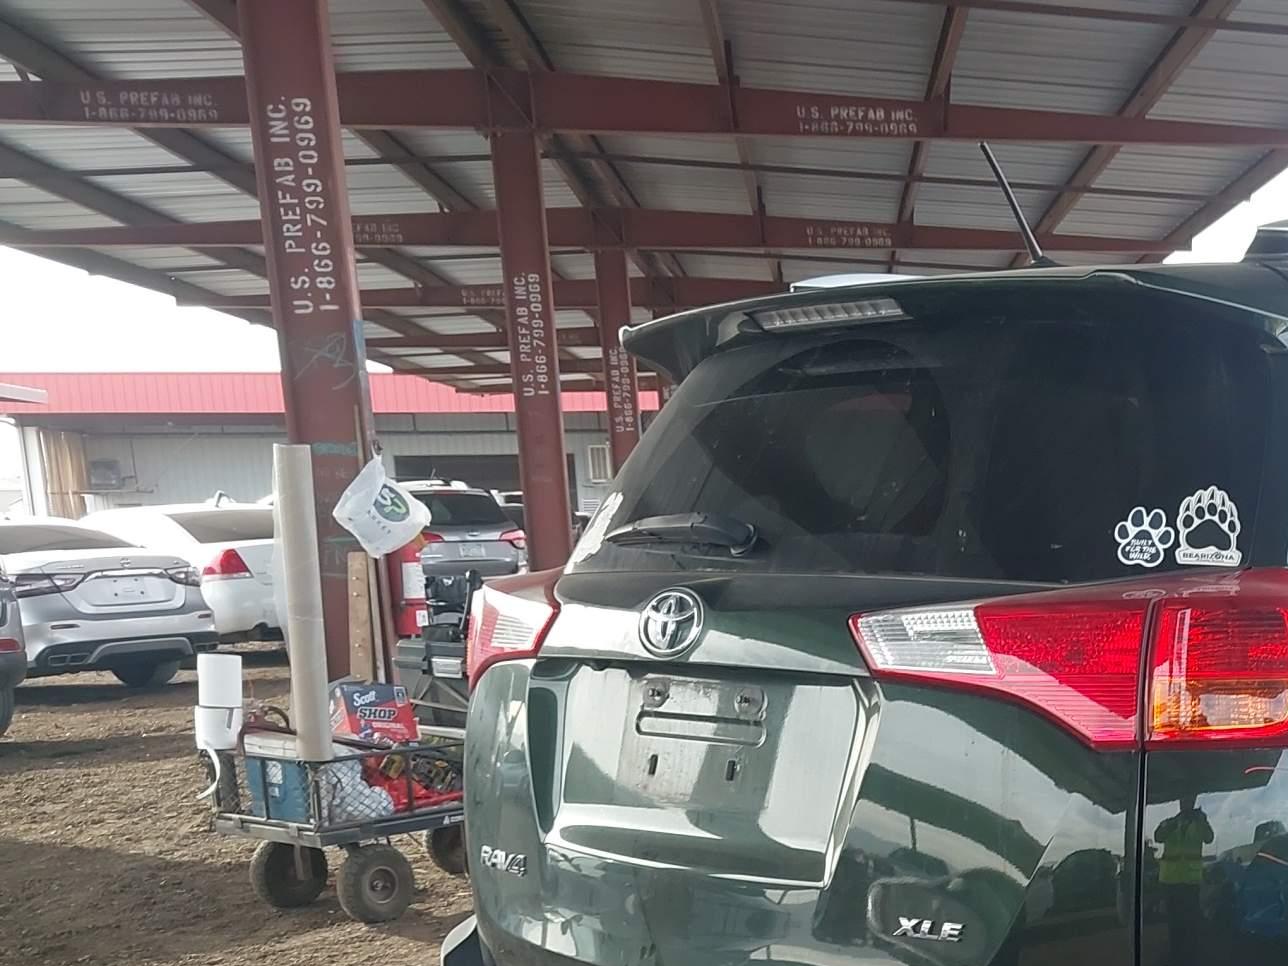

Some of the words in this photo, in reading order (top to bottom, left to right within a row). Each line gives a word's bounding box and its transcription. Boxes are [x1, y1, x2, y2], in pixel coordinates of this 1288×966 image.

[119, 91, 181, 106] PREFAB
[266, 95, 291, 143] INC.
[830, 105, 885, 121] PREFAB
[274, 157, 306, 253] PREFAB
[291, 97, 340, 312] 1-866-799-0969
[290, 267, 315, 315] U.S.
[513, 272, 529, 300] INC.
[516, 306, 532, 362] PREFAB
[528, 273, 549, 395] 1-866-799-0969
[522, 369, 536, 397] U.S.
[1182, 551, 1235, 560] BEARIZONA
[353, 691, 376, 706] Scott
[359, 708, 397, 719] SHOP
[481, 845, 527, 877] RAV4
[892, 916, 965, 942] XLE
